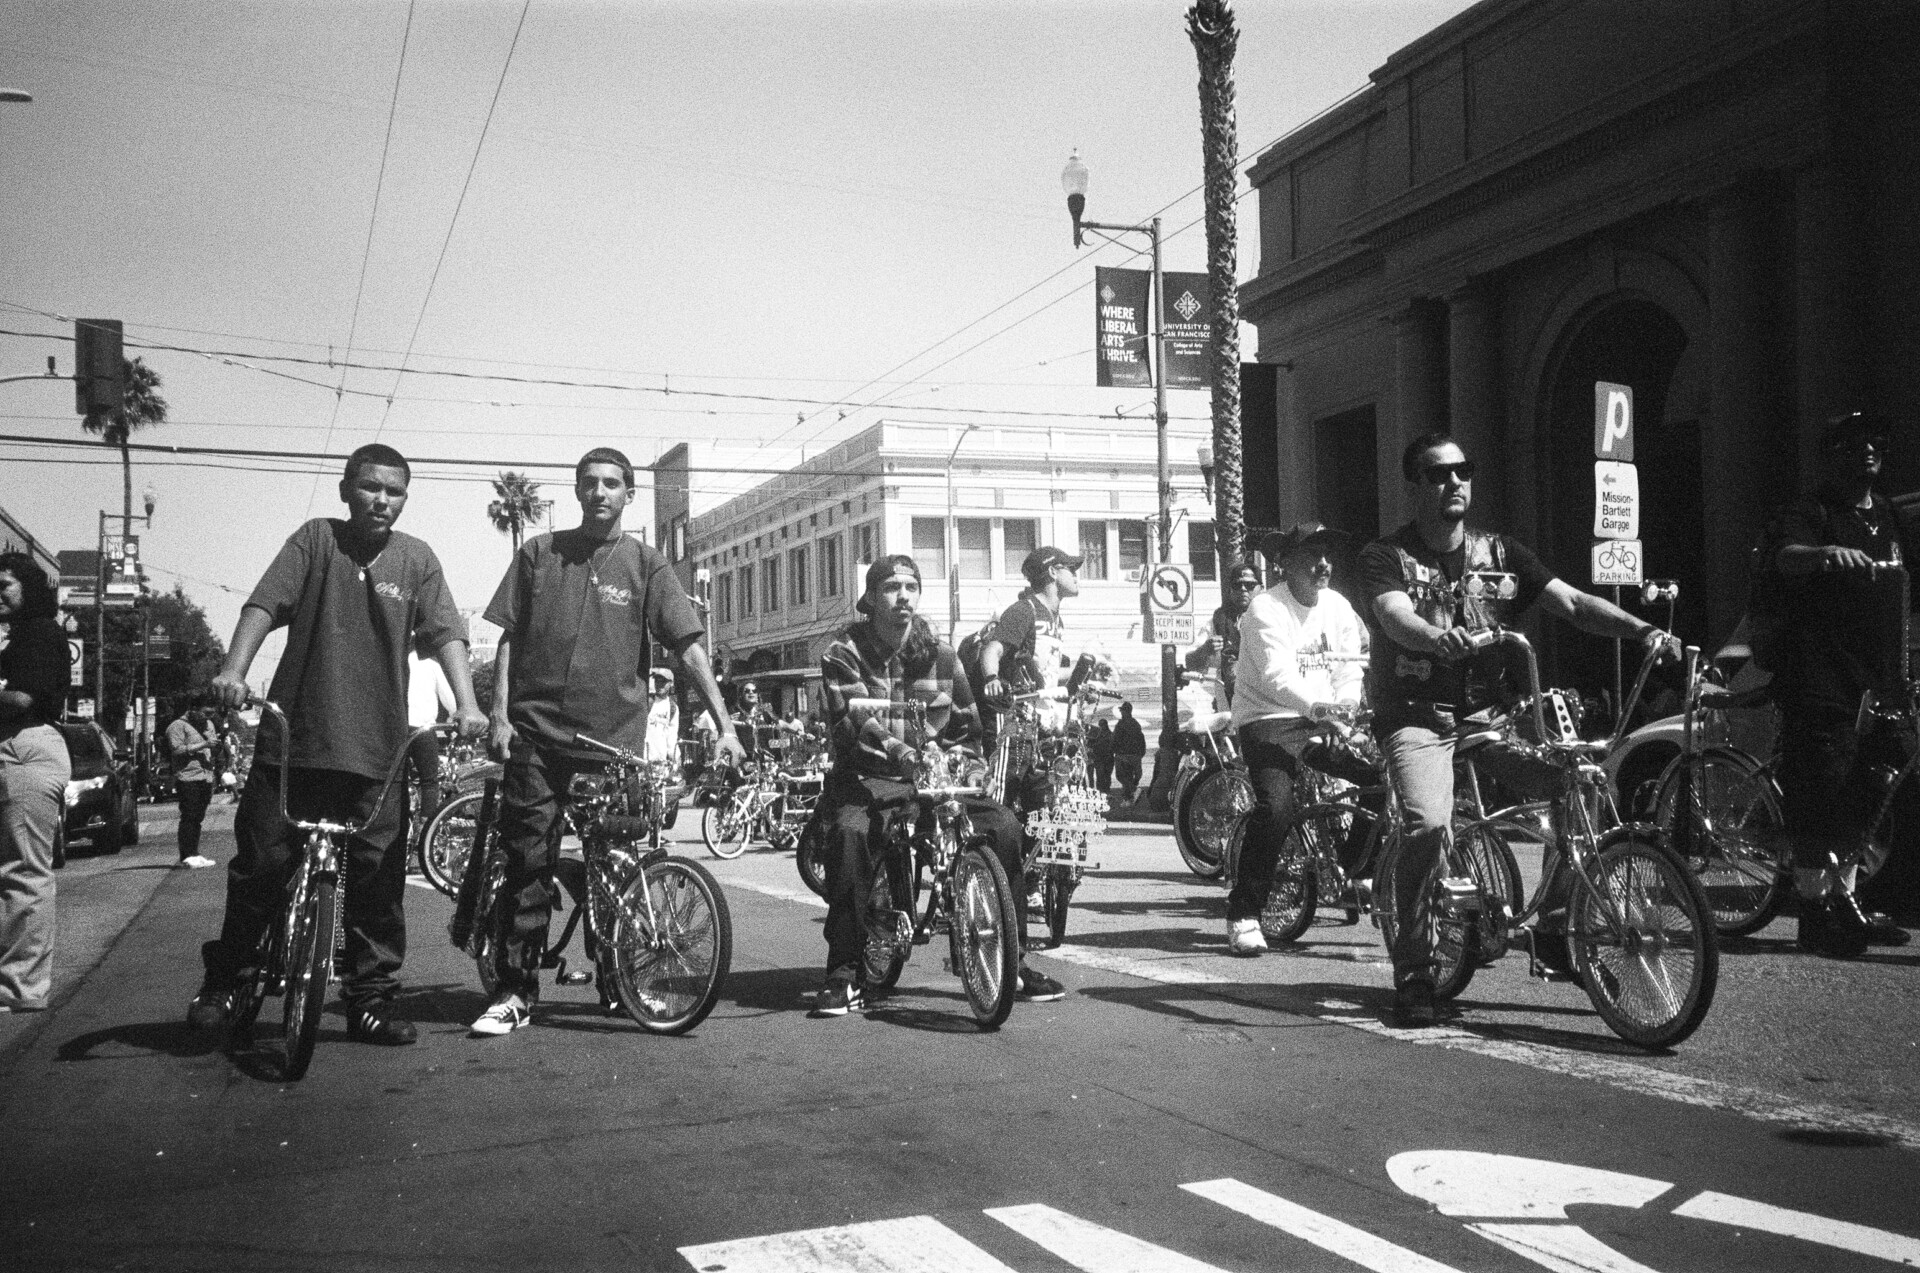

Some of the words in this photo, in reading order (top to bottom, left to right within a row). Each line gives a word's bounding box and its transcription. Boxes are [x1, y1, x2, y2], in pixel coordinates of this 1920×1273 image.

[1101, 306, 1135, 320] WHERE
[1101, 320, 1138, 335] LIBERAL
[1101, 333, 1125, 348] ARTS
[1101, 348, 1138, 363] THRIVE.
[1602, 504, 1631, 517] Bartlett
[1602, 517, 1630, 533] Garage
[1600, 572, 1637, 582] PARKING
[1155, 619, 1174, 627] XCEPT
[1176, 619, 1192, 627] MUNI
[1170, 630, 1189, 640] TAXIS
